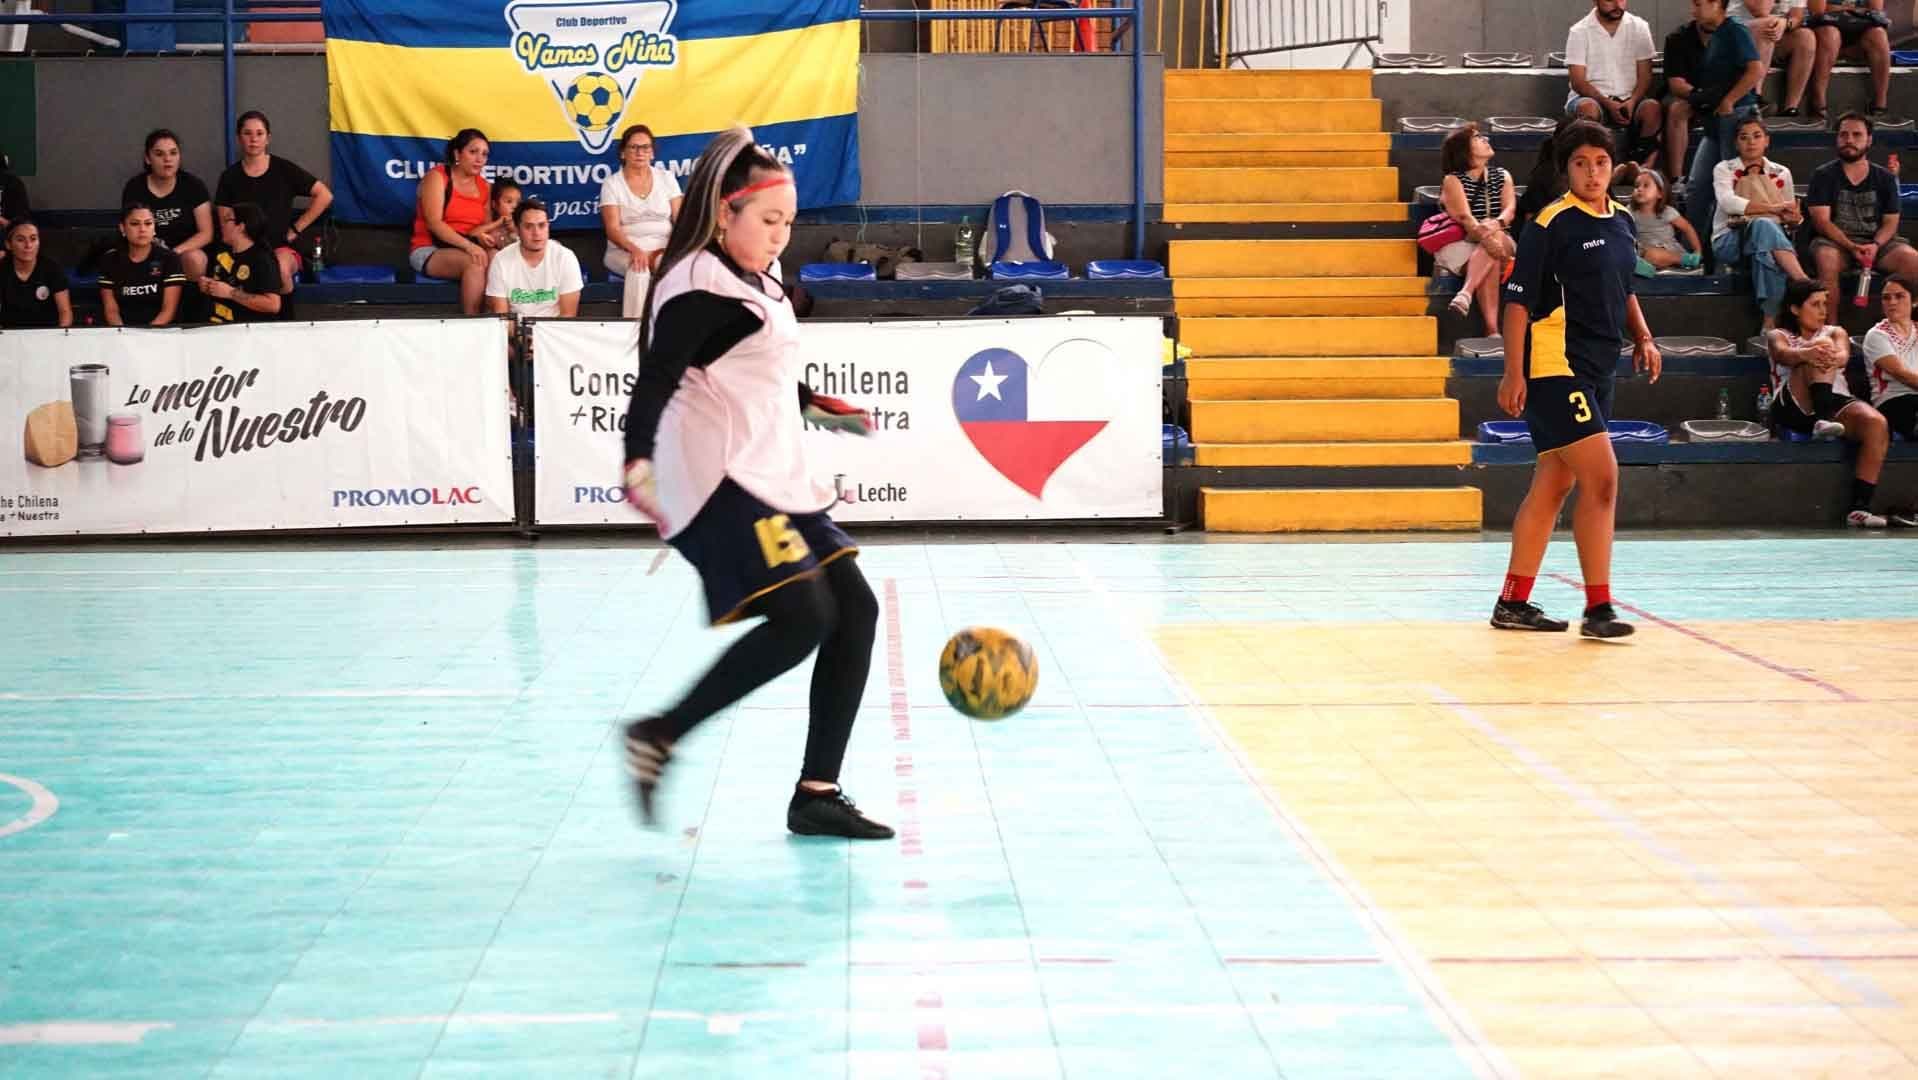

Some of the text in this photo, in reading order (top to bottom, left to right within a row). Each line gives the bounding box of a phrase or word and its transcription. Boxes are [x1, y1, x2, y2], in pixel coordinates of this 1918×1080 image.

[556, 15, 627, 28] Club Deportivo
[517, 31, 674, 73] Vamos Niña
[481, 164, 612, 185] EPORTIVO
[549, 193, 601, 223] pasi
[122, 283, 158, 297] RECTV
[569, 362, 909, 397] Cons Chilena
[124, 366, 260, 422] Lo mejor
[1568, 391, 1592, 423] 3
[154, 390, 366, 462] de lo Nuestro
[17, 495, 59, 508] Chilena
[333, 486, 482, 507] PROMOLAC
[574, 486, 627, 504] PRO
[858, 482, 908, 502] Leche
